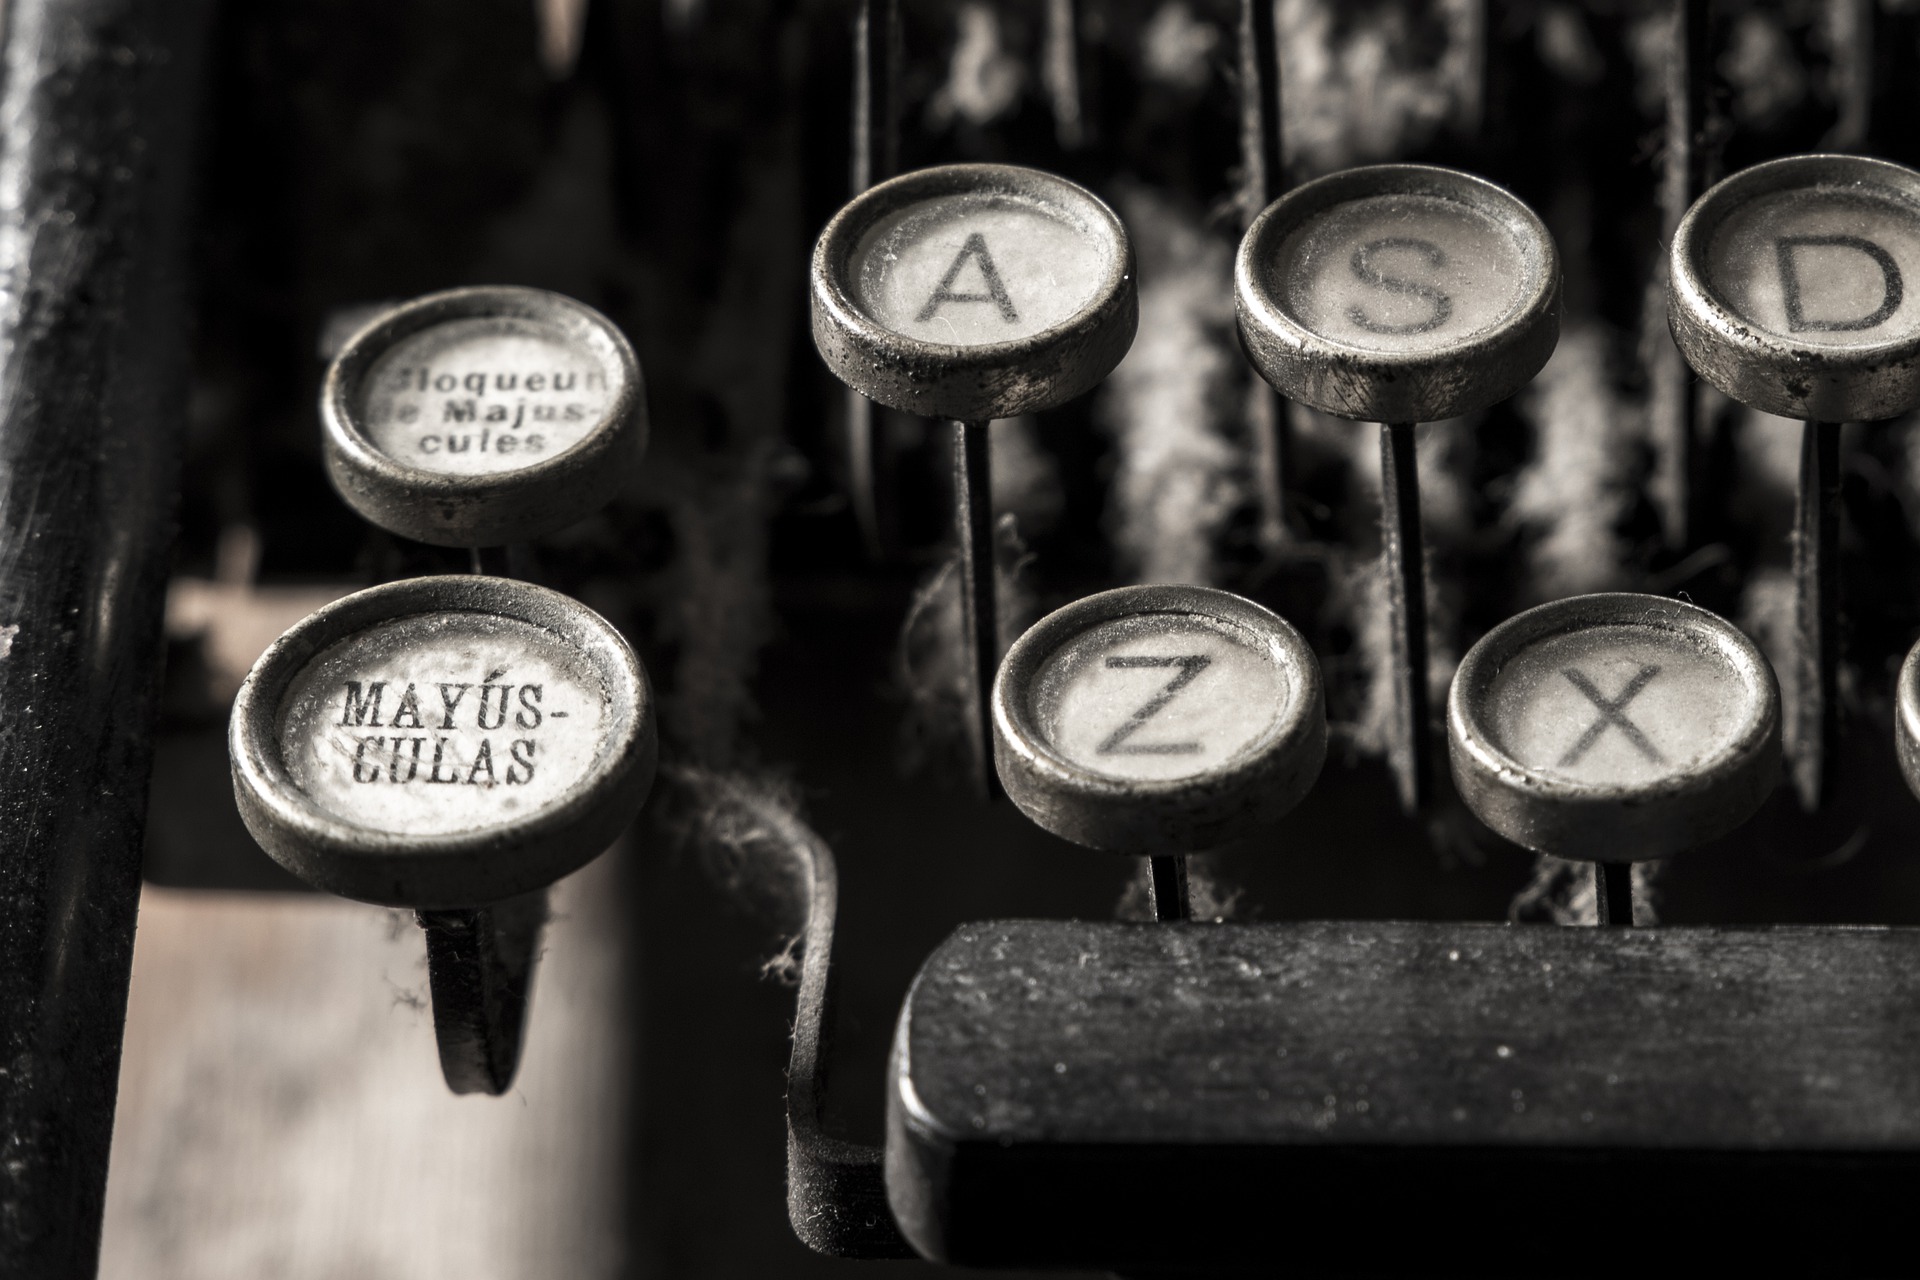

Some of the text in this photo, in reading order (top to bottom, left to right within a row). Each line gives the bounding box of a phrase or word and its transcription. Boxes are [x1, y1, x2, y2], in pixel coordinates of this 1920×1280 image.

[914, 232, 1021, 323] A
[1345, 236, 1452, 336] S
[1775, 234, 1903, 332] D
[419, 429, 546, 454] cules
[337, 665, 569, 730] MAYÚS-
[1096, 655, 1211, 755] Z
[1558, 664, 1666, 767] X
[353, 736, 537, 785] CULAS
